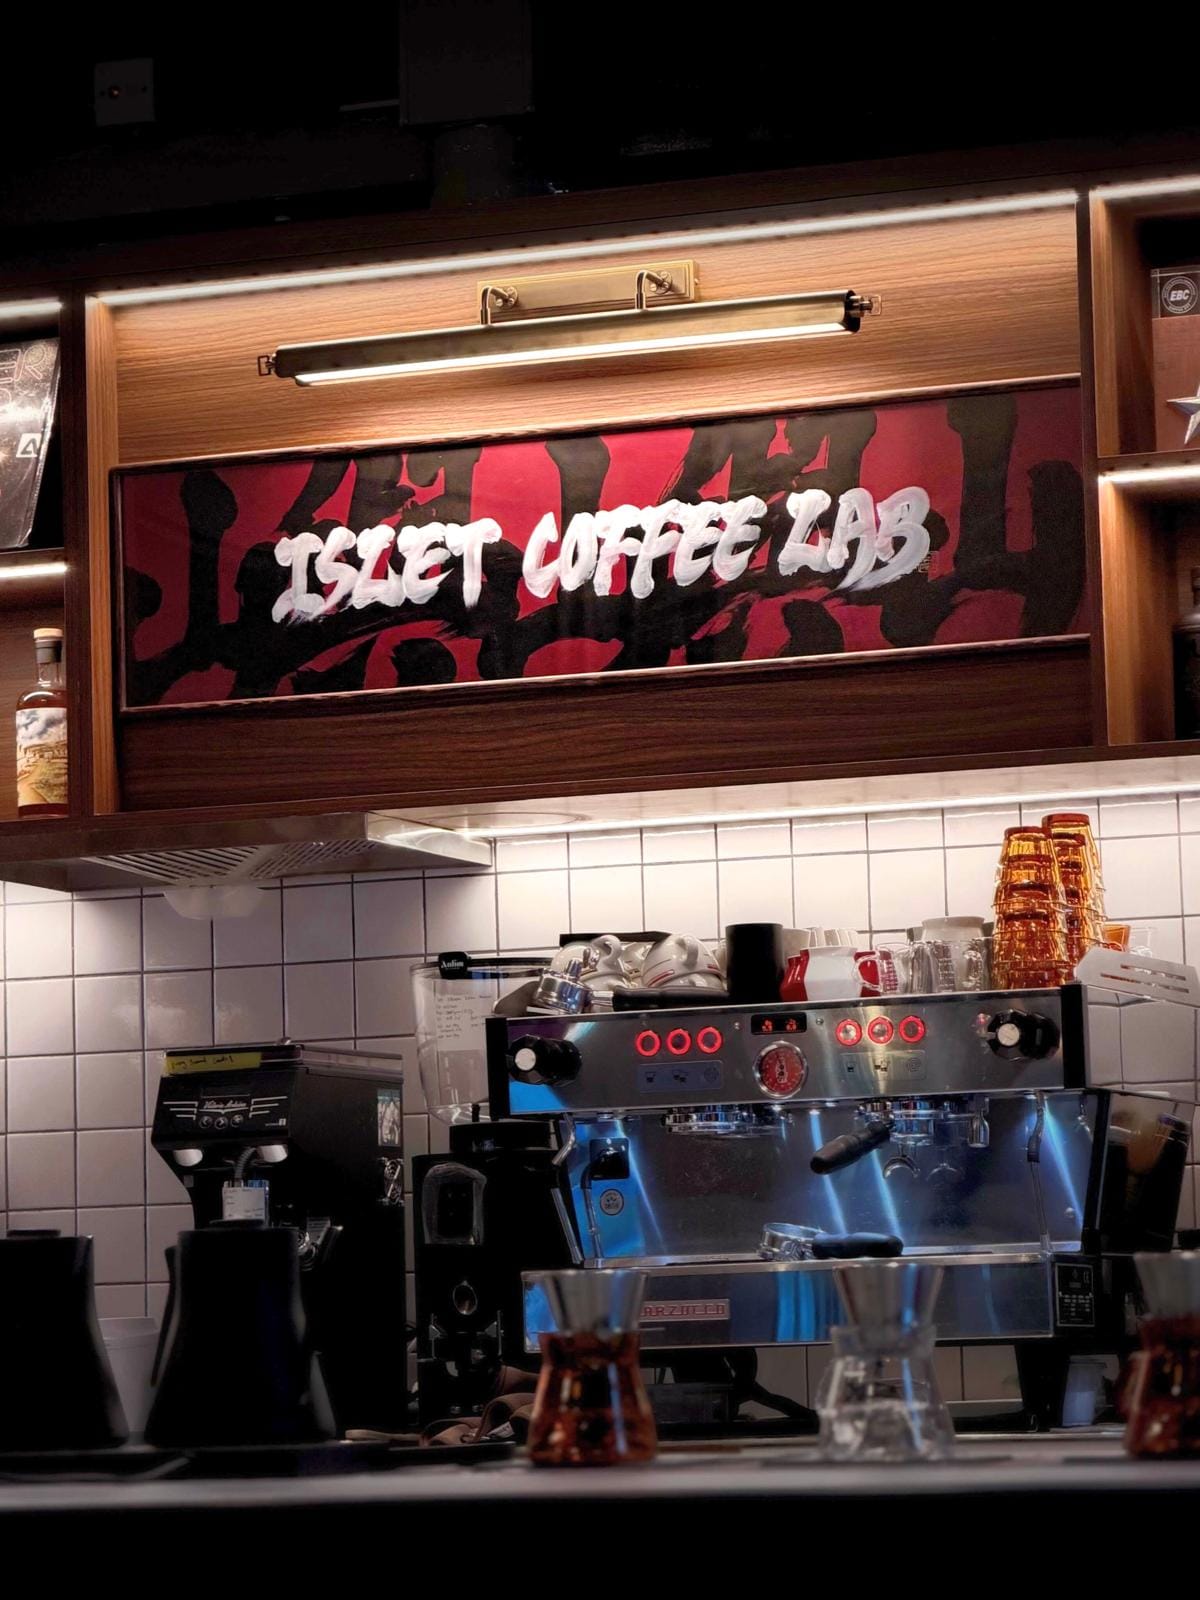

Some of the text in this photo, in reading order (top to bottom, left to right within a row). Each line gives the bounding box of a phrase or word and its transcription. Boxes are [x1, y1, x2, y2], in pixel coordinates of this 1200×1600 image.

[1170, 289, 1190, 301] EBC
[273, 487, 930, 622] ISLET COFFEE LAB
